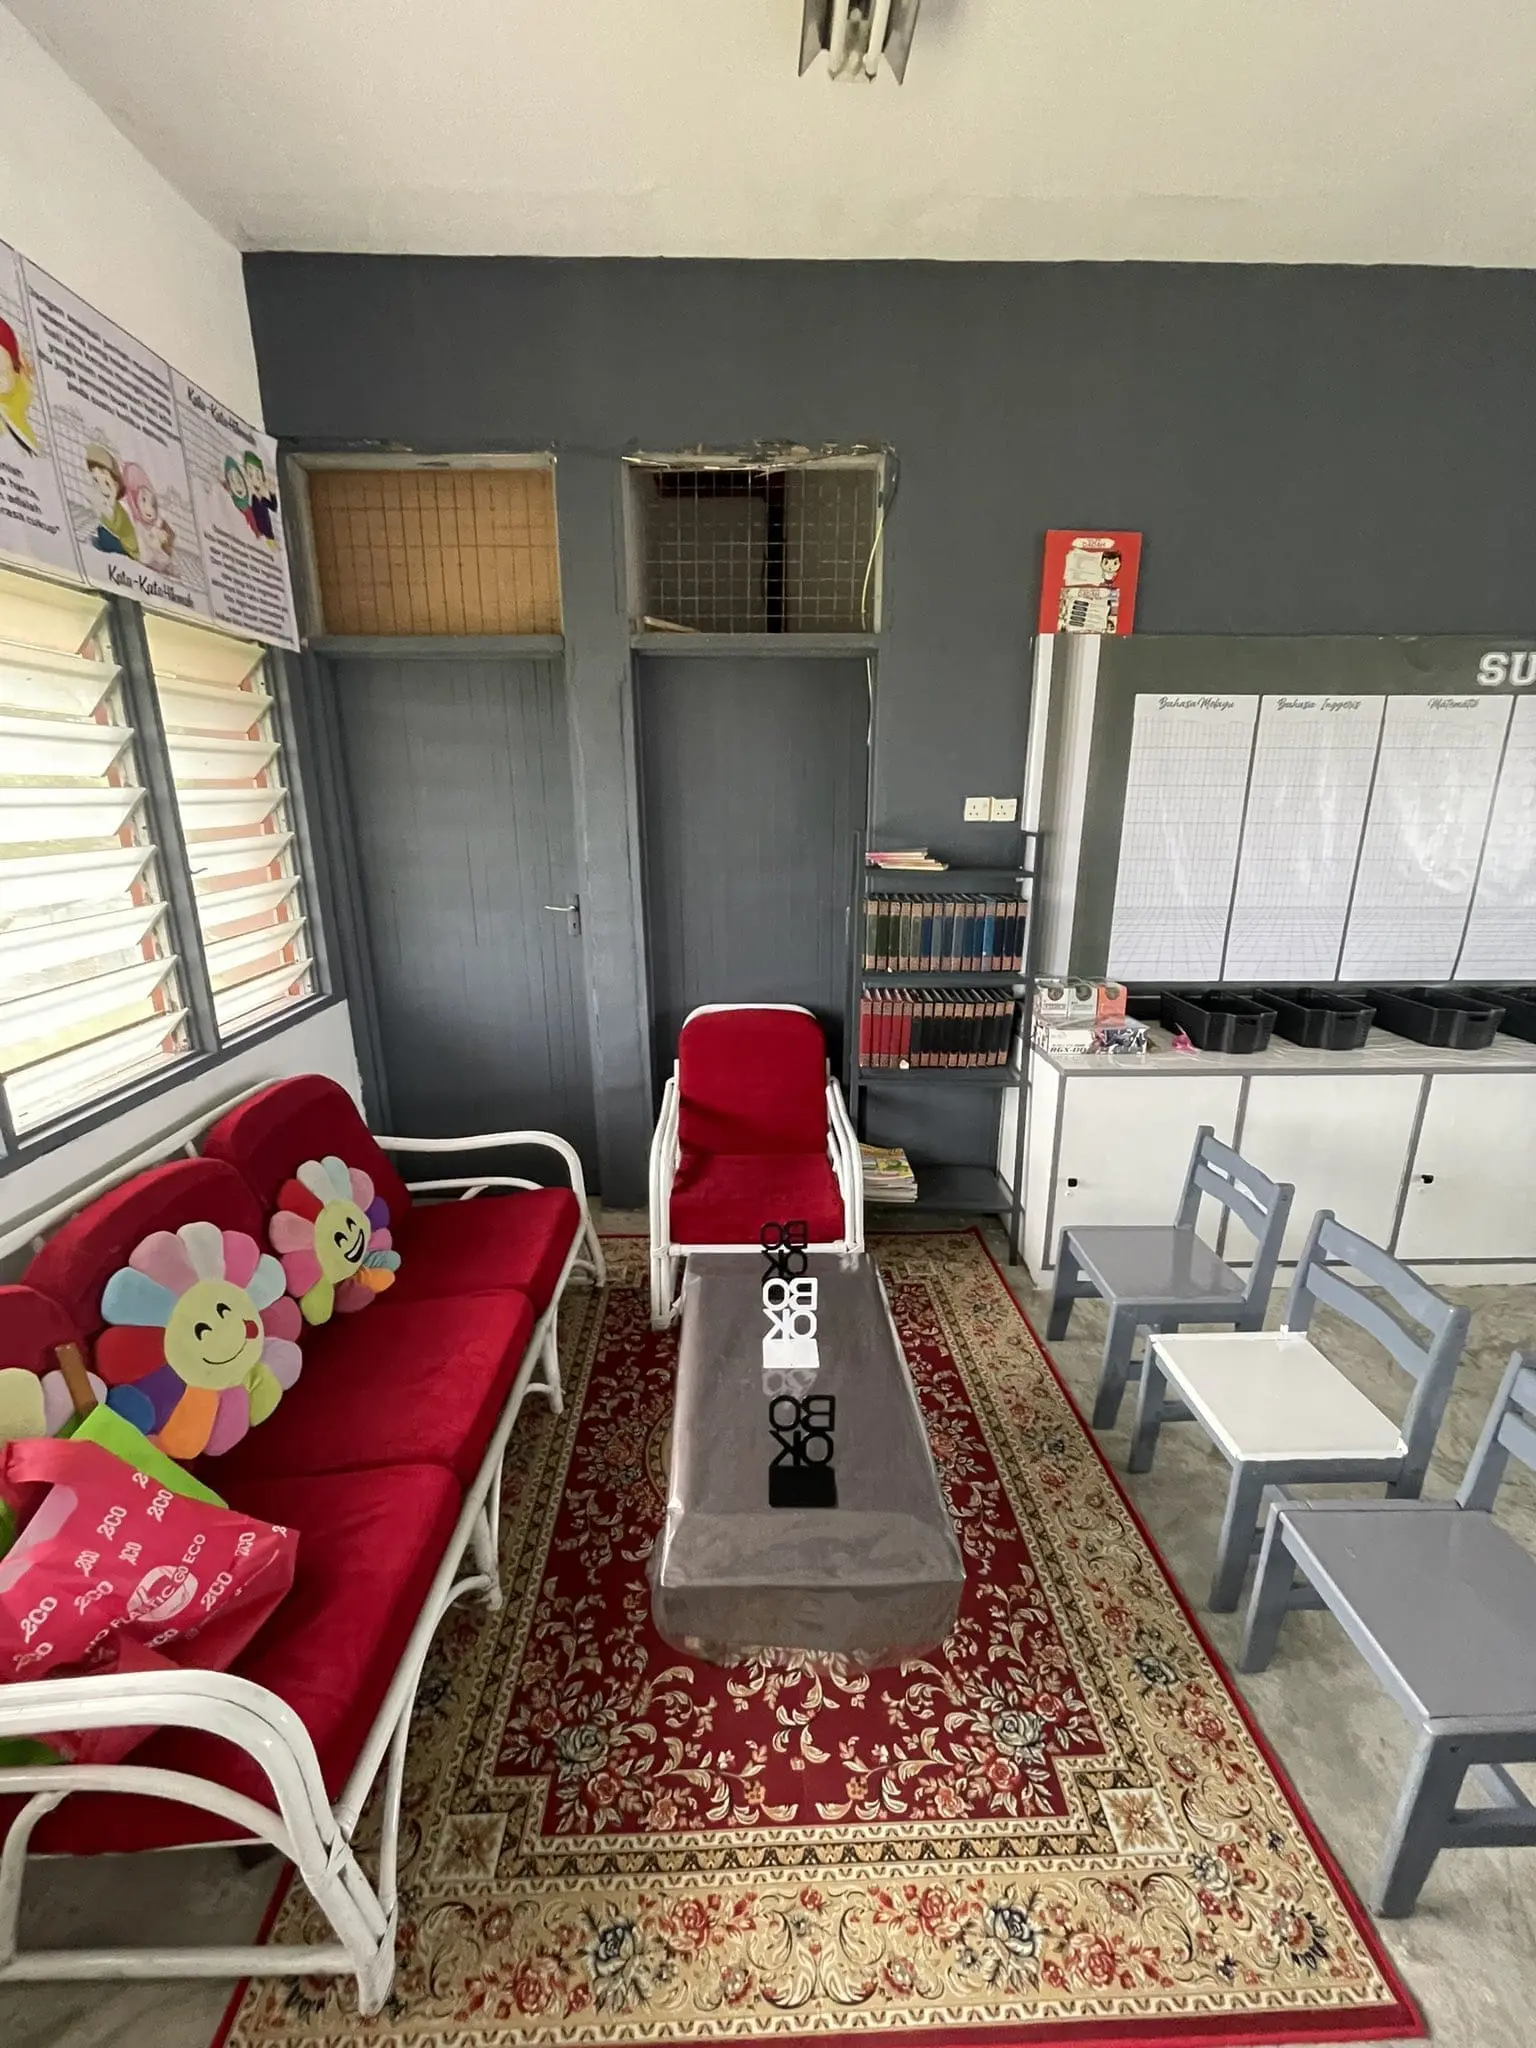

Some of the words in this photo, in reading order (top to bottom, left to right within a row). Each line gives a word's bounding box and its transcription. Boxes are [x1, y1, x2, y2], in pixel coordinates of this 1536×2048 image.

[1158, 697, 1197, 710] Bahasa
[1198, 697, 1235, 711] Melayu
[1276, 698, 1316, 710] Bahasa
[182, 1534, 206, 1564] ECO
